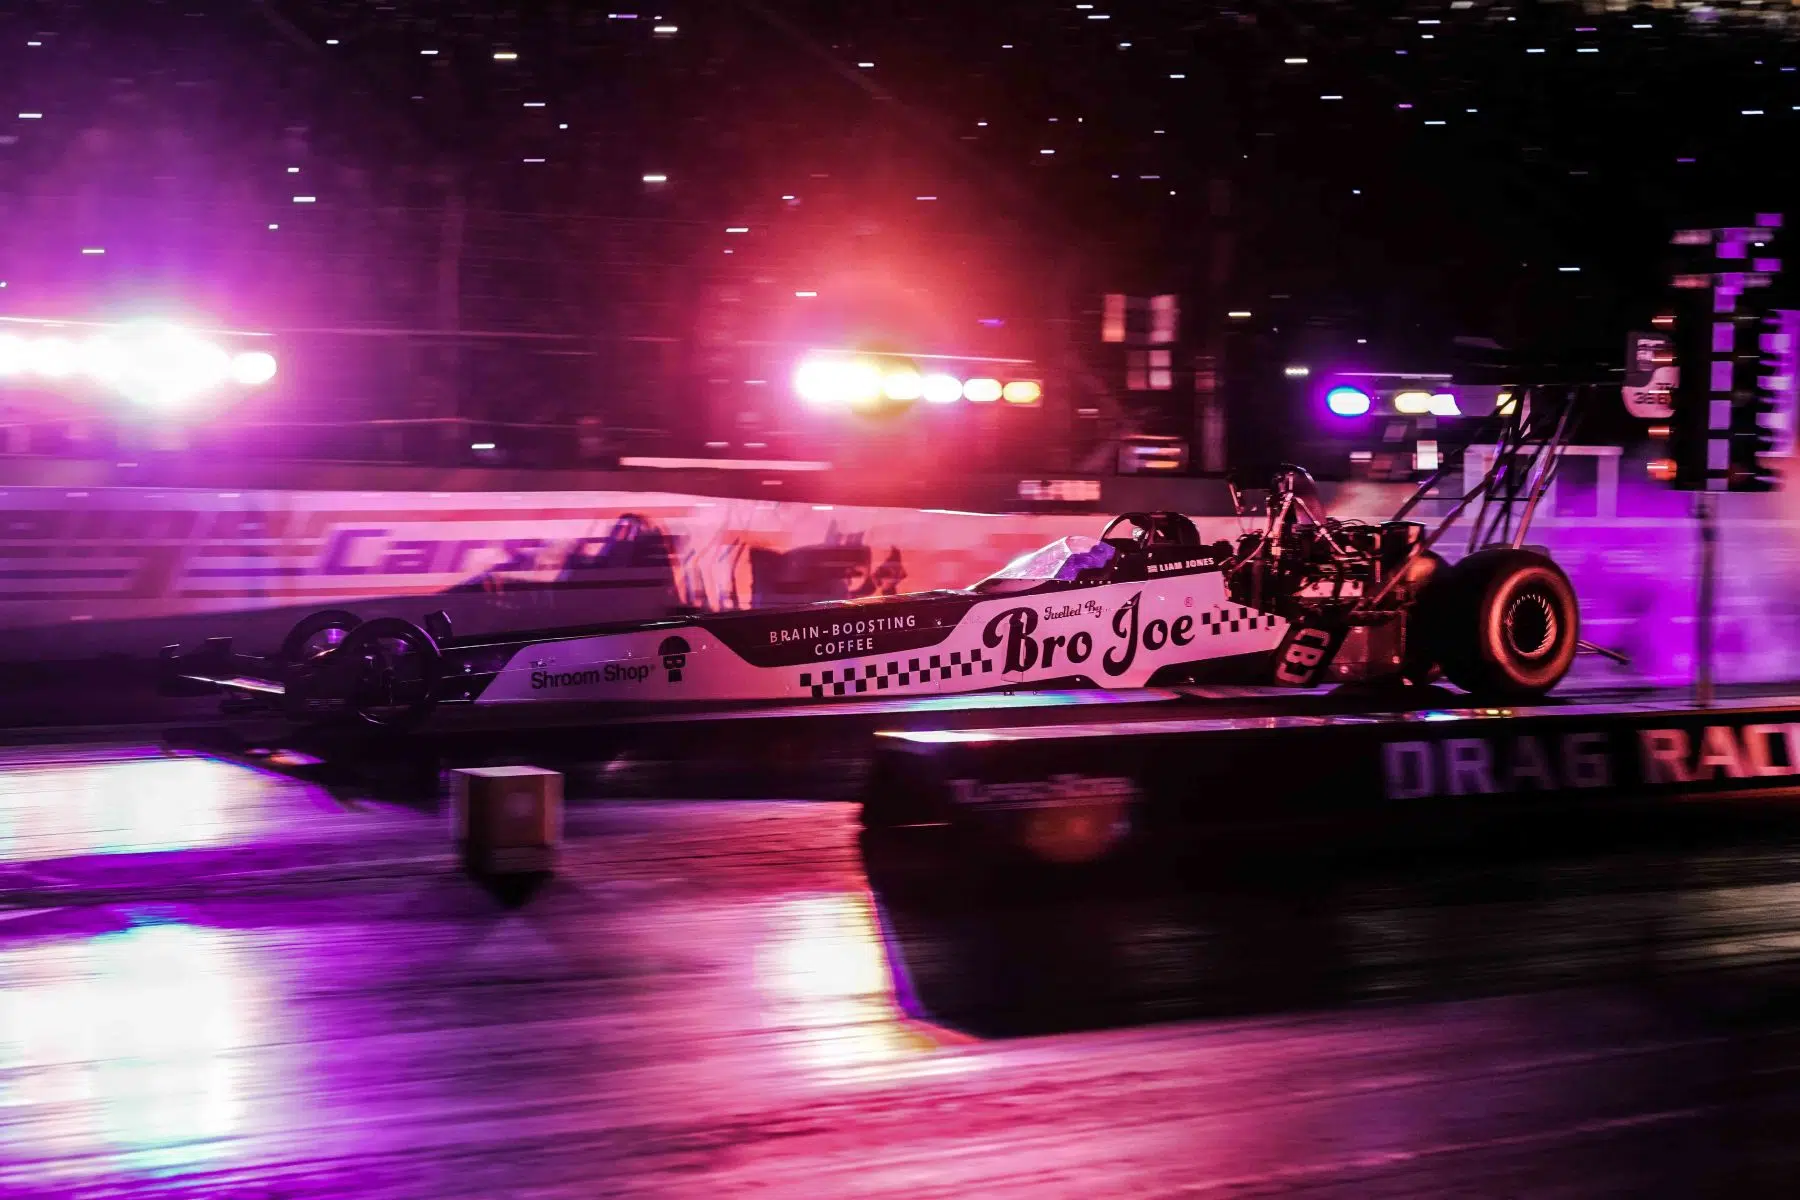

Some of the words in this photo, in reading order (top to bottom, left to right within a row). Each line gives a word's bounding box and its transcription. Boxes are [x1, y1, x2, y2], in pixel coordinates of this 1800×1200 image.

[1159, 561, 1183, 572] LIAM
[1185, 557, 1215, 569] JONES
[1043, 603, 1082, 620] Fuelled
[769, 615, 916, 643] BRAIN-BOOSTING
[982, 607, 1093, 675] Bro
[1102, 590, 1196, 677] Joe
[814, 637, 874, 656] COFFEE
[531, 670, 600, 689] Shroom
[1380, 732, 1614, 800] DRAG
